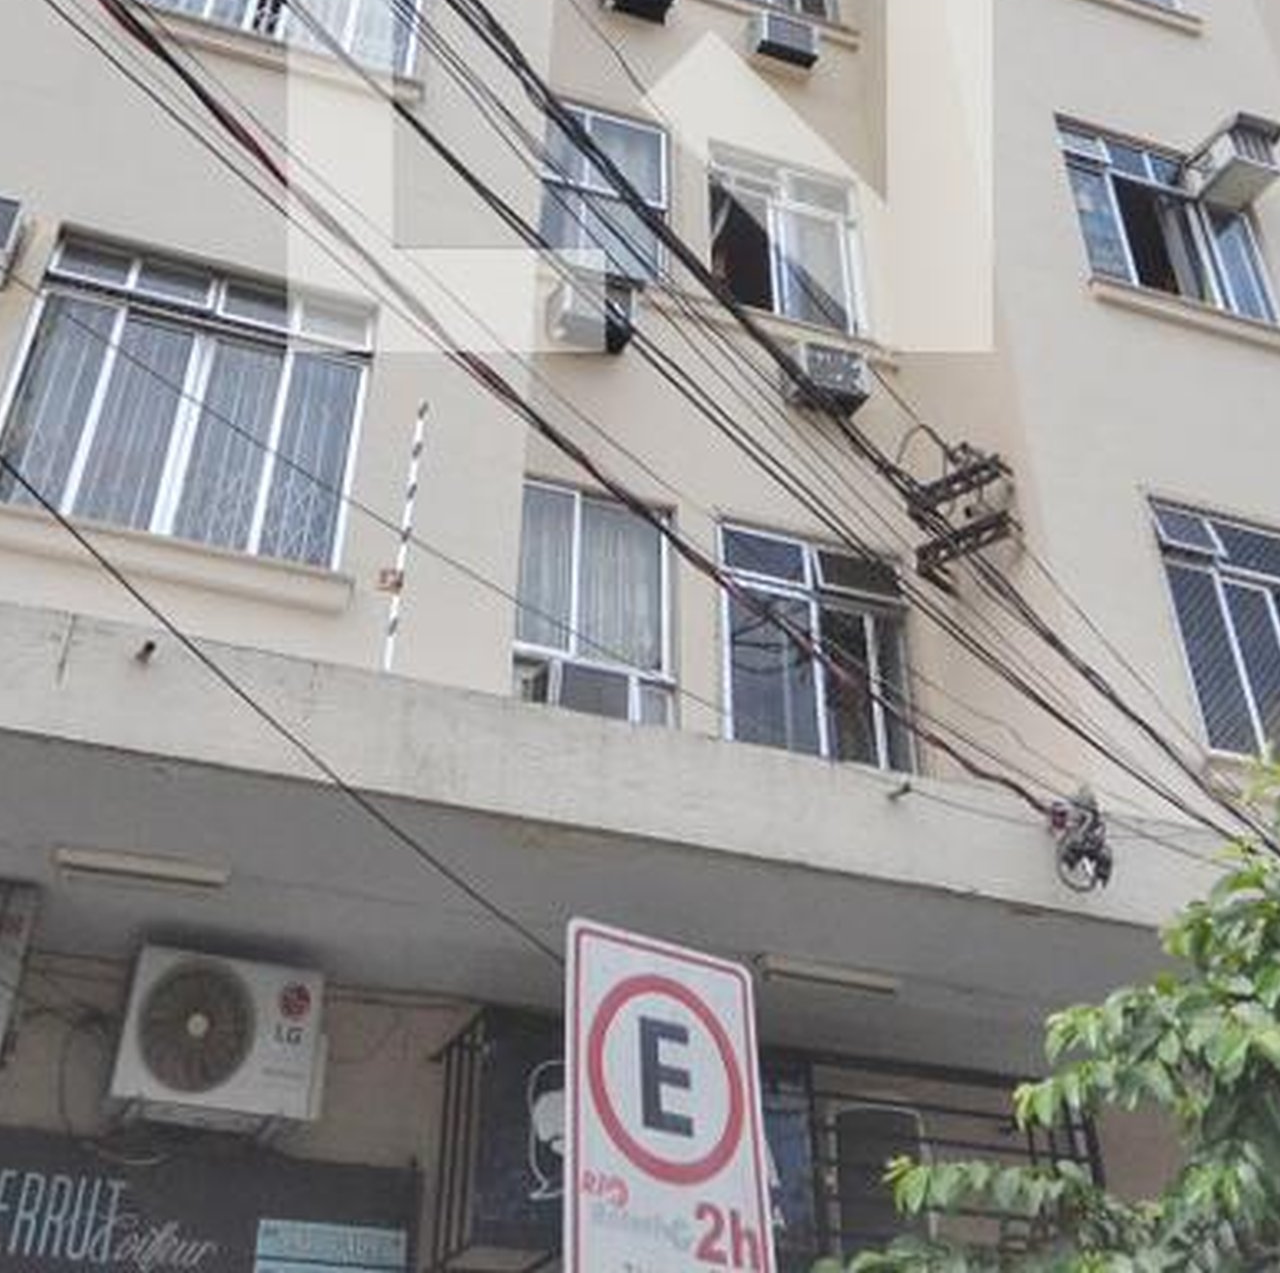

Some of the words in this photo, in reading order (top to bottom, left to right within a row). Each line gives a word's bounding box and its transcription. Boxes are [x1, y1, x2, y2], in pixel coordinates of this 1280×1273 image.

[273, 1022, 304, 1045] LG
[638, 1016, 694, 1138] E
[695, 1202, 760, 1270] 2h
